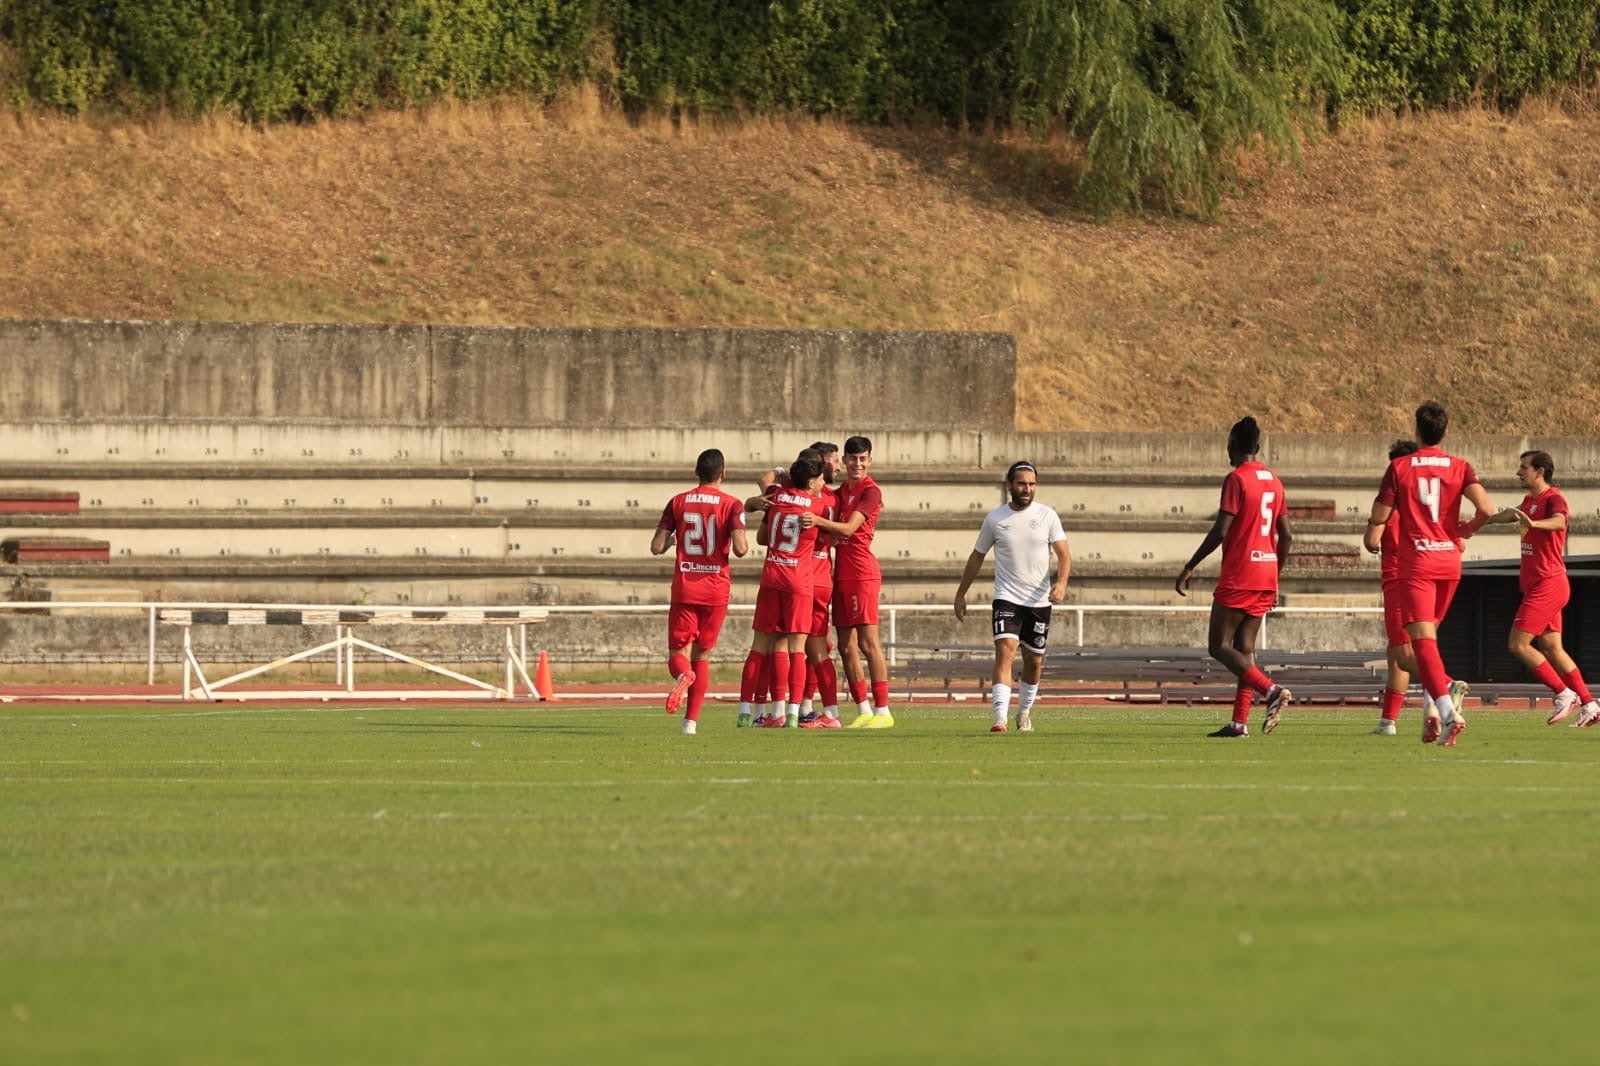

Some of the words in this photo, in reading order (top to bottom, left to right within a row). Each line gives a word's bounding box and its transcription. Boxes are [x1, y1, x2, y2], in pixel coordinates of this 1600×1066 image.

[1261, 491, 1275, 537] 5
[1417, 477, 1441, 523] 4
[683, 511, 716, 557] 21
[769, 511, 801, 554] 19
[994, 620, 1005, 634] 11
